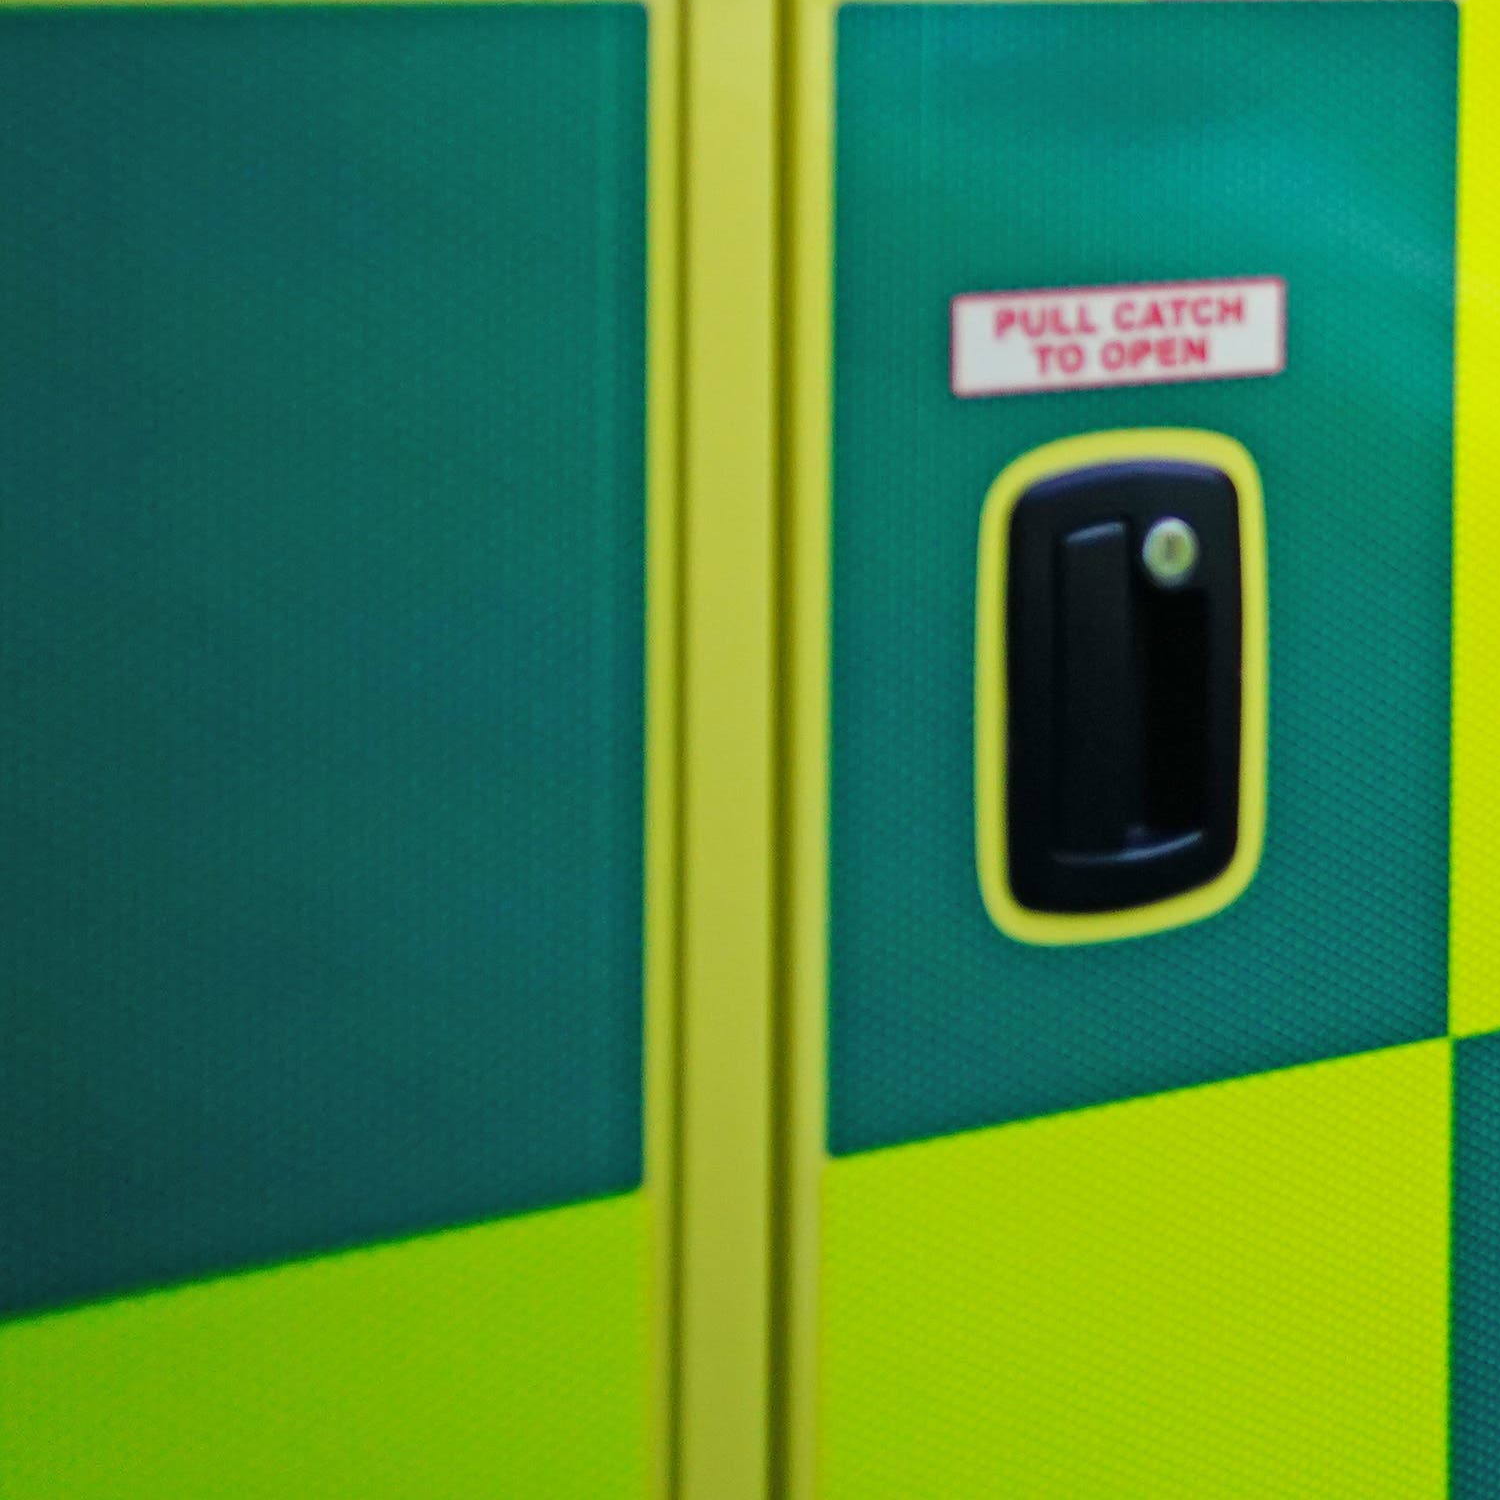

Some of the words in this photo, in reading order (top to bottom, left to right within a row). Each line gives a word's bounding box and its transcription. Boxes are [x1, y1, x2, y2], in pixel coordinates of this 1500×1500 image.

[995, 306, 1096, 341] PULL
[1113, 297, 1243, 331] CATCH
[1035, 345, 1084, 377] TO
[1101, 338, 1208, 370] OPEN
